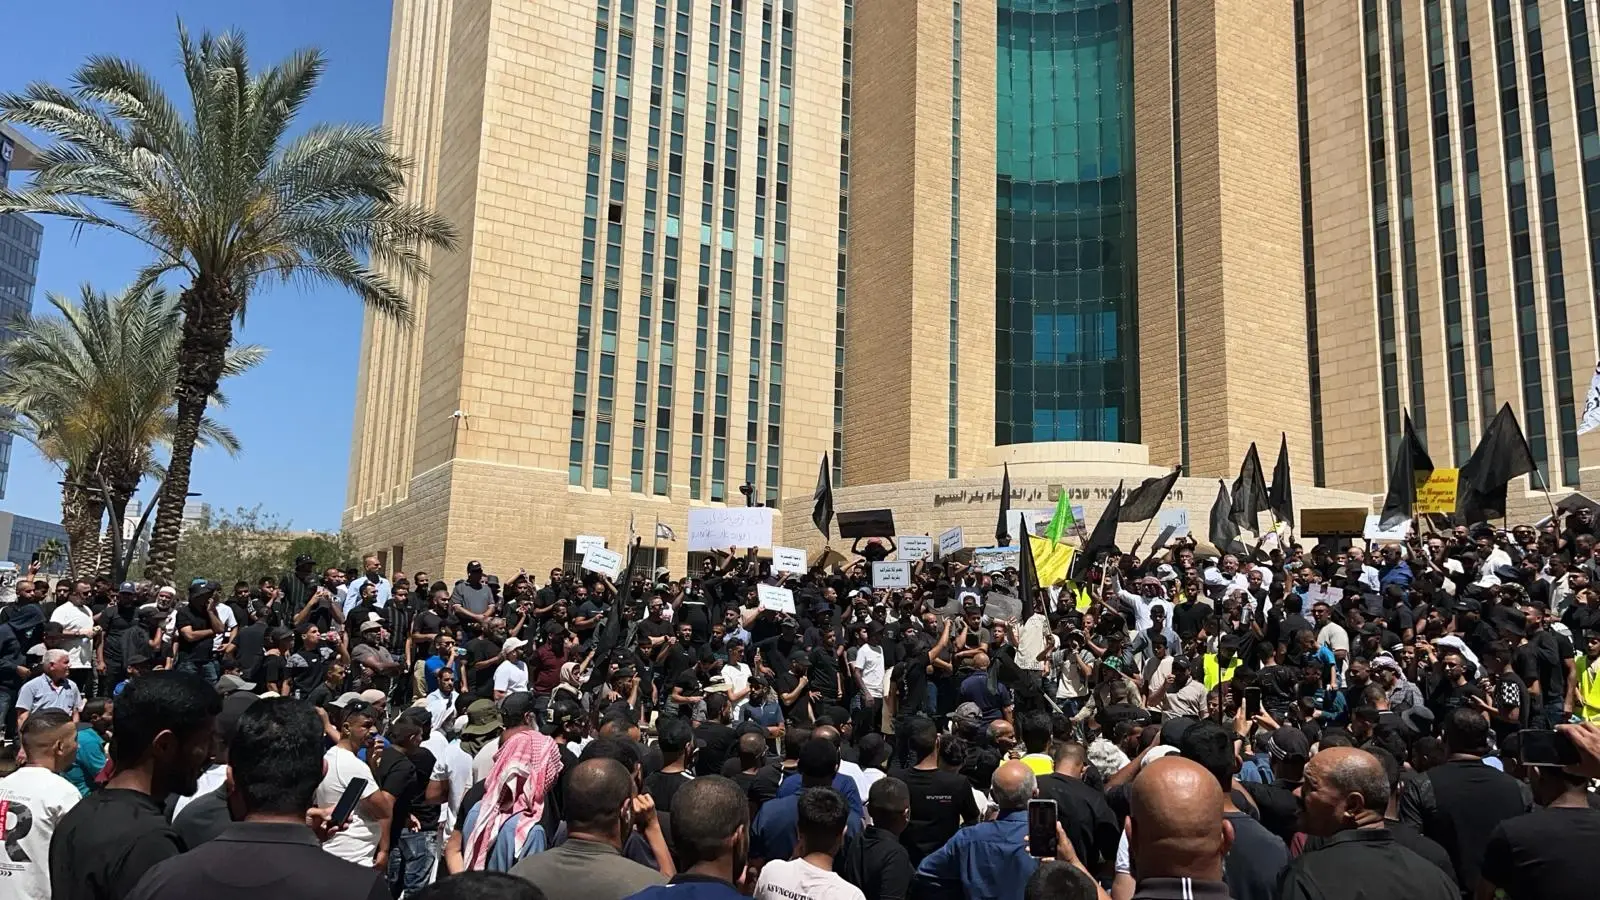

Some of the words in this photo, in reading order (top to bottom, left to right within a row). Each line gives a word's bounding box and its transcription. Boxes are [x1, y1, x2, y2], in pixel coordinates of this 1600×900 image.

[934, 489, 967, 508] السبع
[986, 488, 1026, 501] القاء
[1027, 488, 1042, 502] دار
[1068, 487, 1090, 500] שבע
